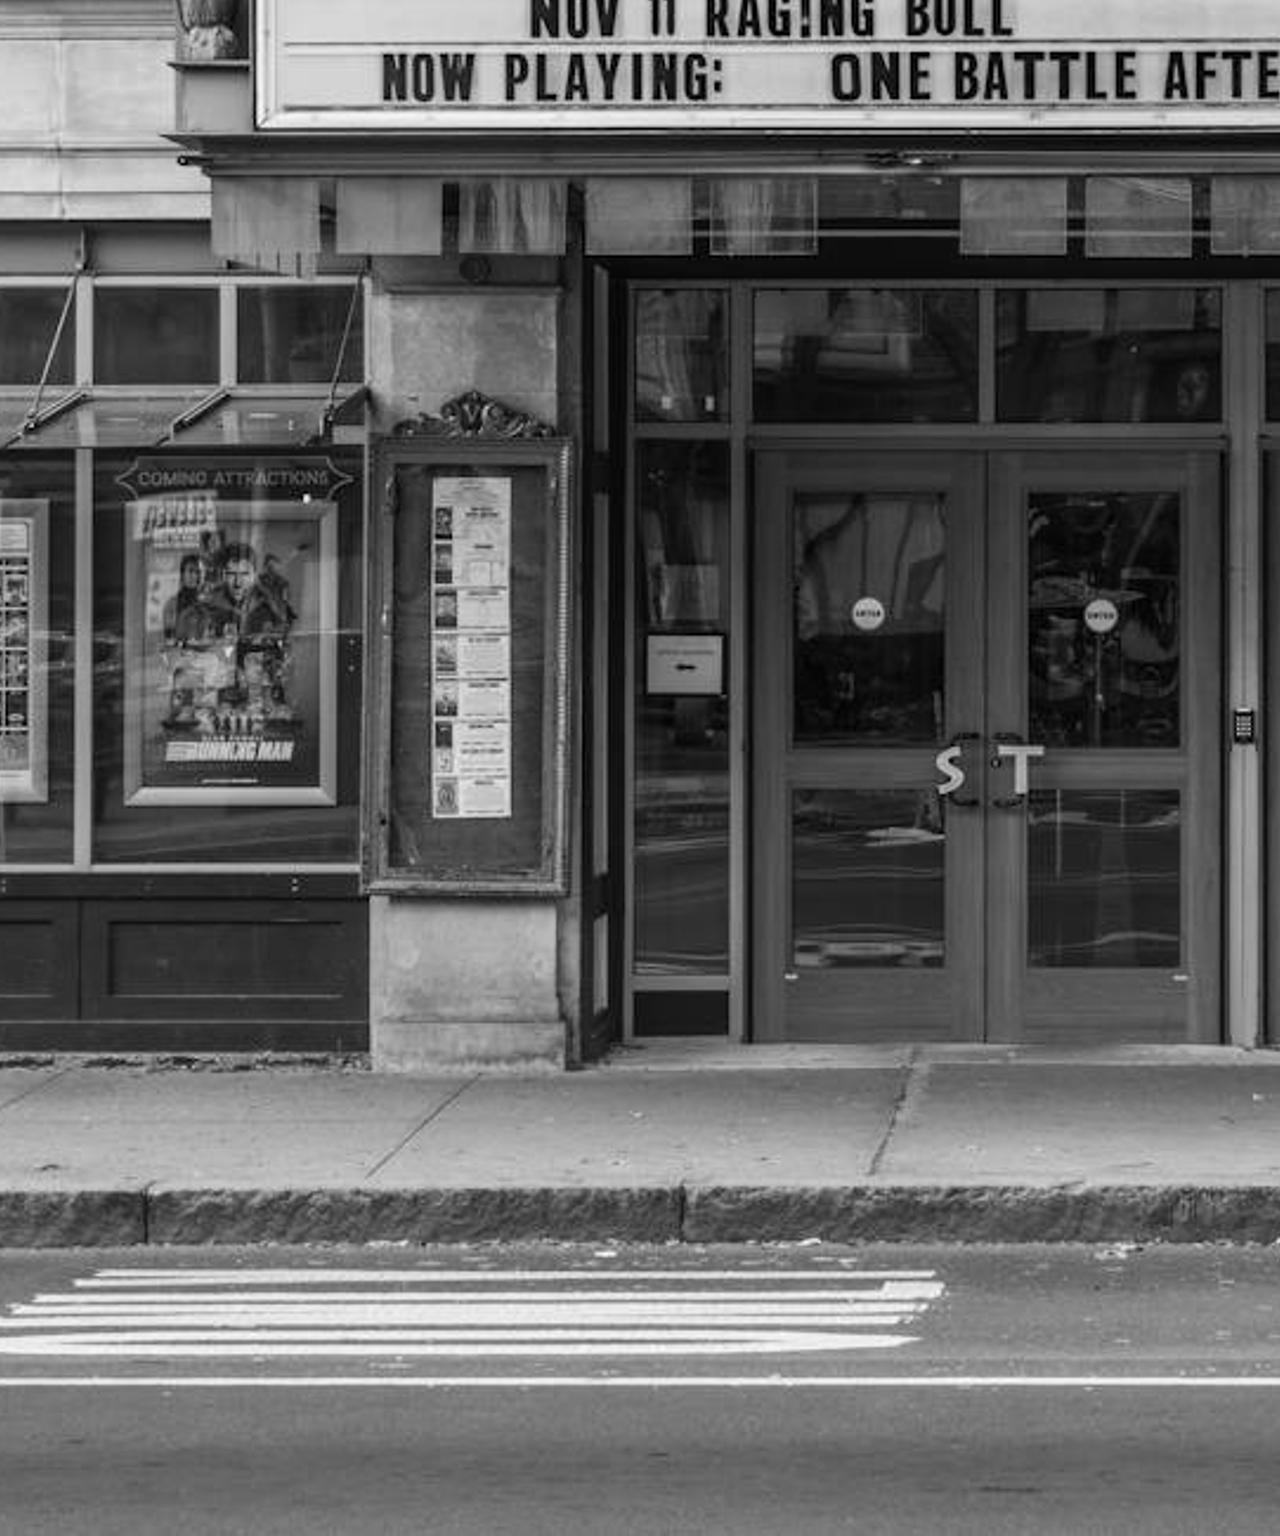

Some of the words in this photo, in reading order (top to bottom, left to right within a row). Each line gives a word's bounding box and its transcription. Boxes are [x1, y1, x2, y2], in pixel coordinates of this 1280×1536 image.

[382, 53, 476, 103] NOW
[505, 52, 722, 102] PLAYING:
[831, 51, 931, 102] ONE
[954, 50, 1137, 101] BATTLE
[138, 470, 207, 486] COMING
[213, 468, 328, 486] ATTRACTIONS
[935, 746, 965, 795] S
[998, 745, 1045, 795] T
